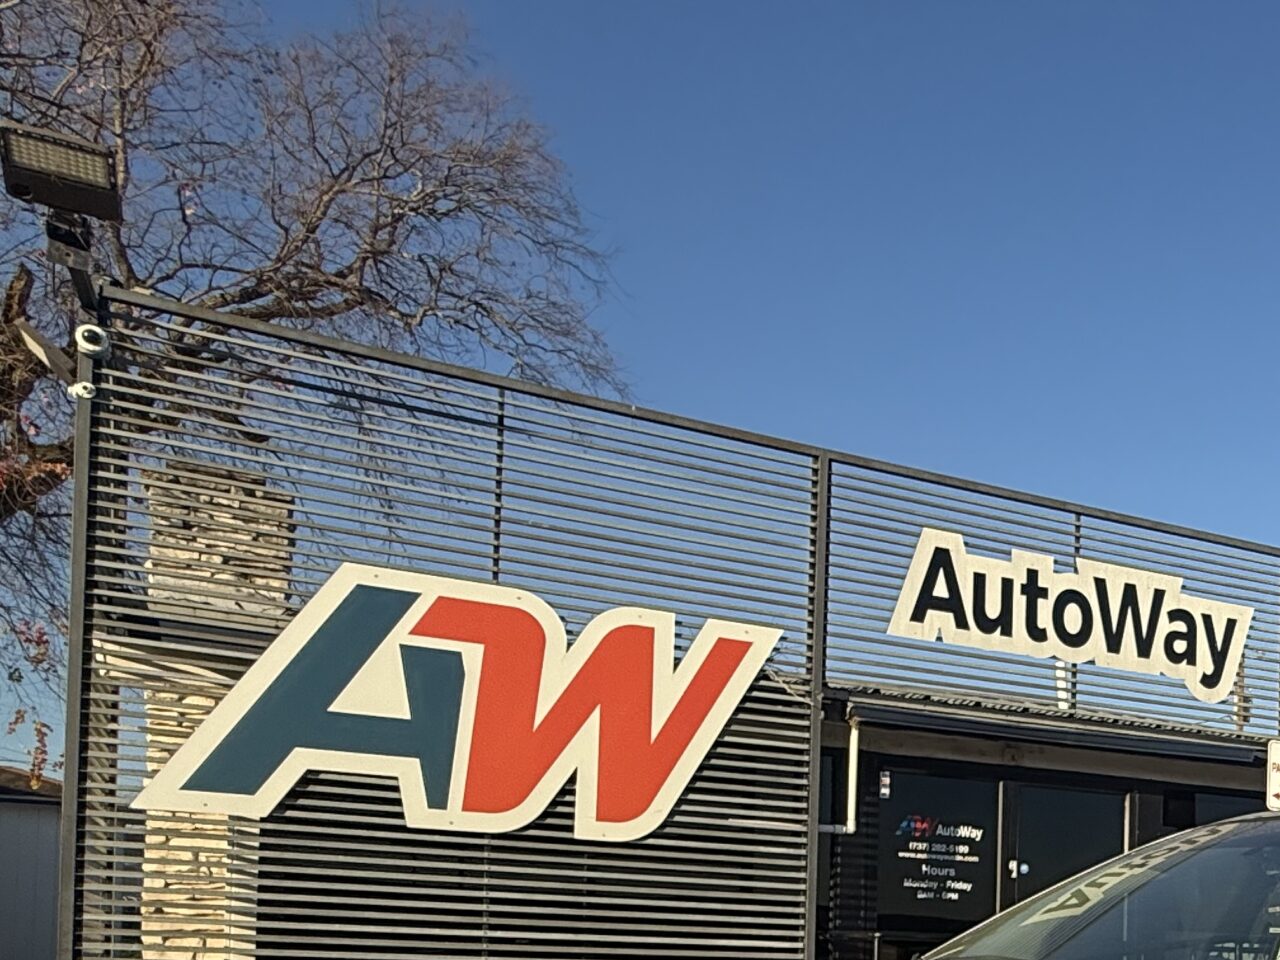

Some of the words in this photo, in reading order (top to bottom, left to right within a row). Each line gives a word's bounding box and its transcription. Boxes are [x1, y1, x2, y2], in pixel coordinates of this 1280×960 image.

[910, 546, 1238, 690] AutoWay
[178, 583, 754, 823] AW
[936, 824, 984, 841] AutoWay
[909, 841, 929, 851] (737)
[922, 863, 956, 876] Hours
[903, 878, 938, 889] Monday
[946, 880, 973, 892] Friday
